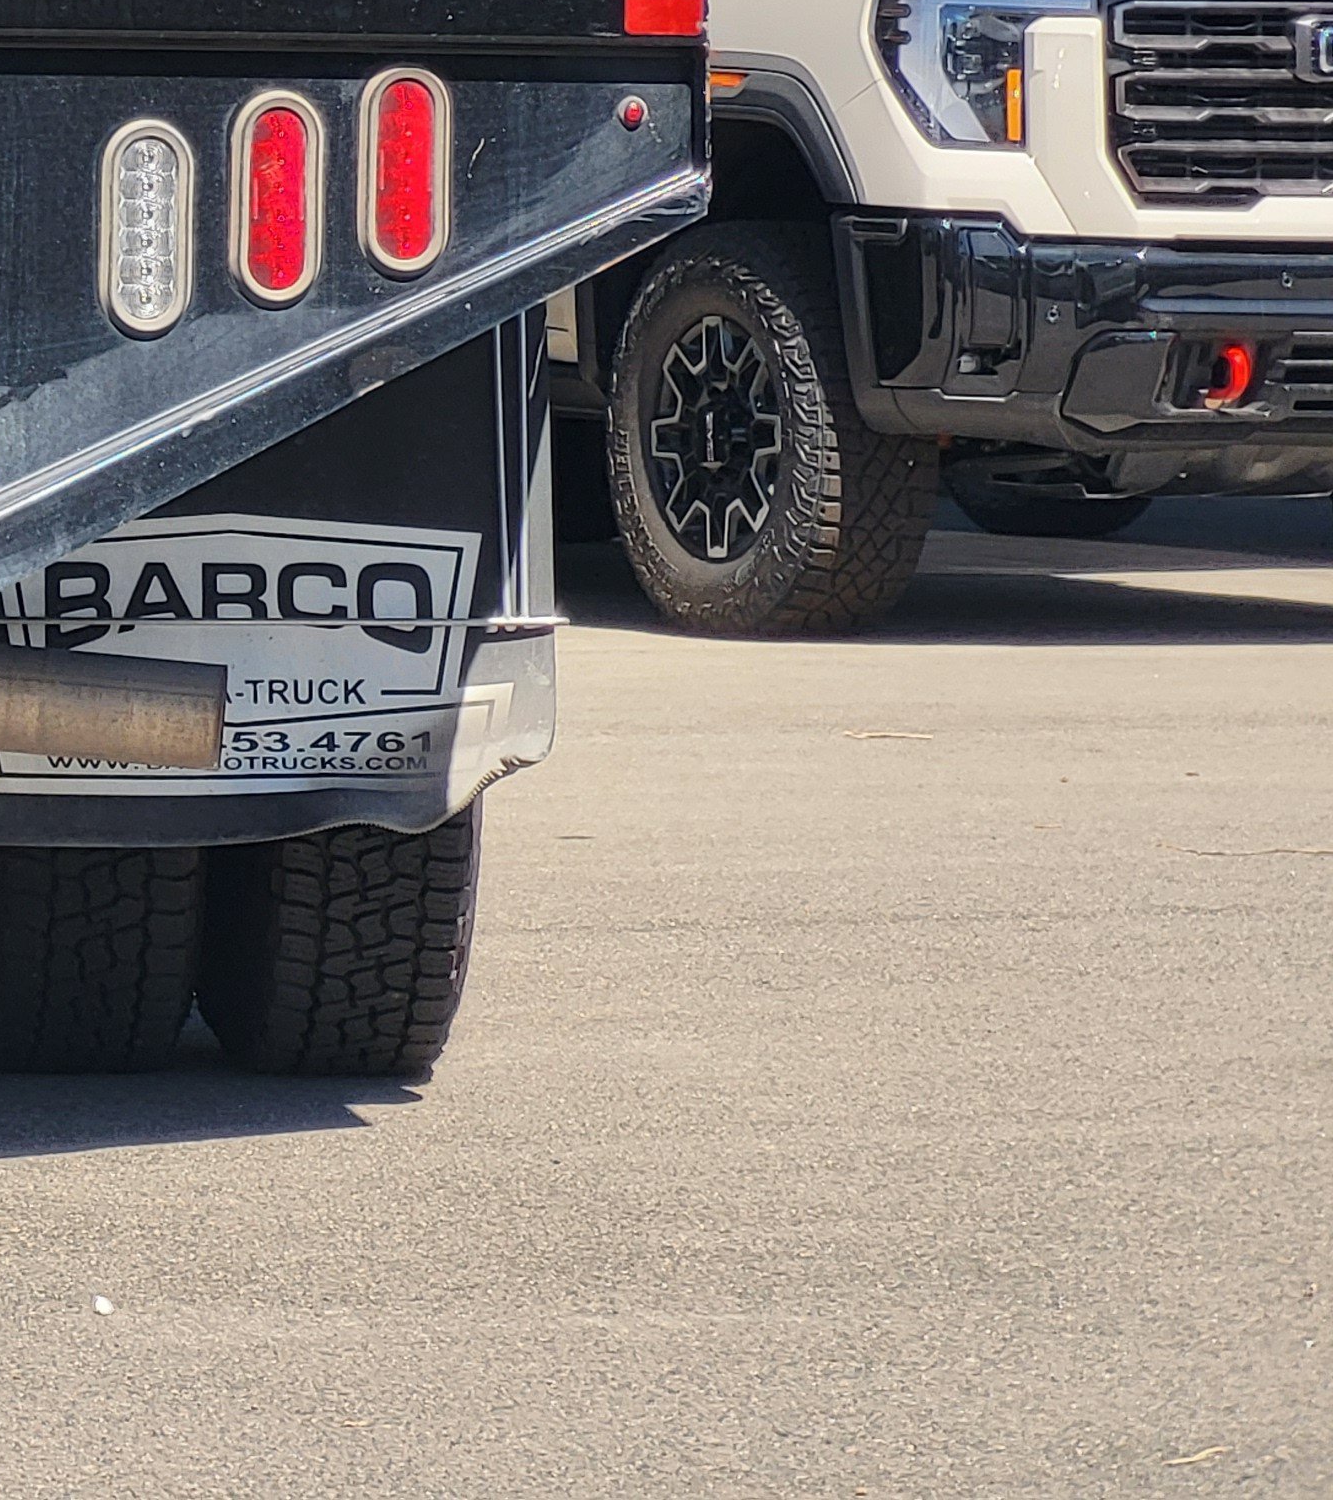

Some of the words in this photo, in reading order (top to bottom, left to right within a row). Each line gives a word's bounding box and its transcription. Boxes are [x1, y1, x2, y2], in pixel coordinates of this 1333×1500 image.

[44, 561, 434, 654] BARCO
[226, 679, 366, 705] -TRUCK
[222, 731, 432, 753] 53.4761
